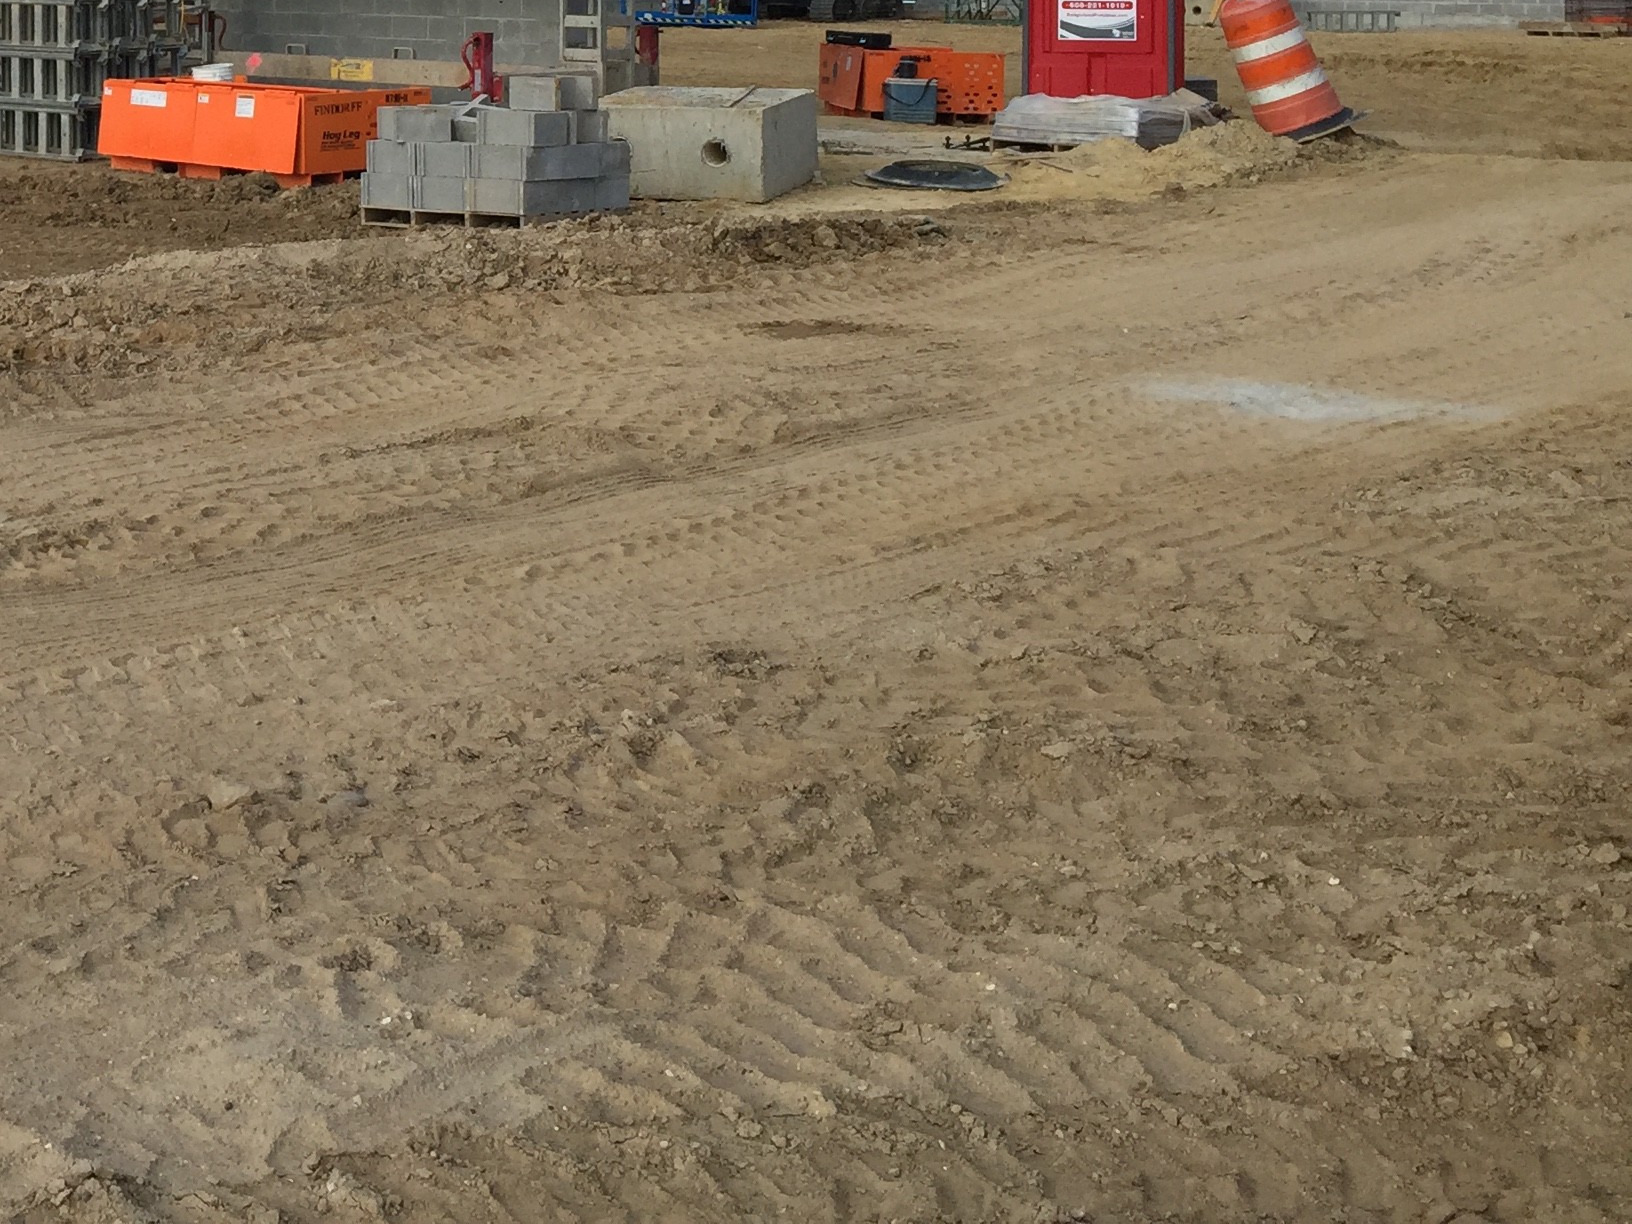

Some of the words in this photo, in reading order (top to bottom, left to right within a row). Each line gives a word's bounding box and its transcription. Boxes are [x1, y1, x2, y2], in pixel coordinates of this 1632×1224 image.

[314, 101, 363, 116] FINDORFF
[322, 130, 341, 142] Hog
[343, 129, 361, 140] Leg
